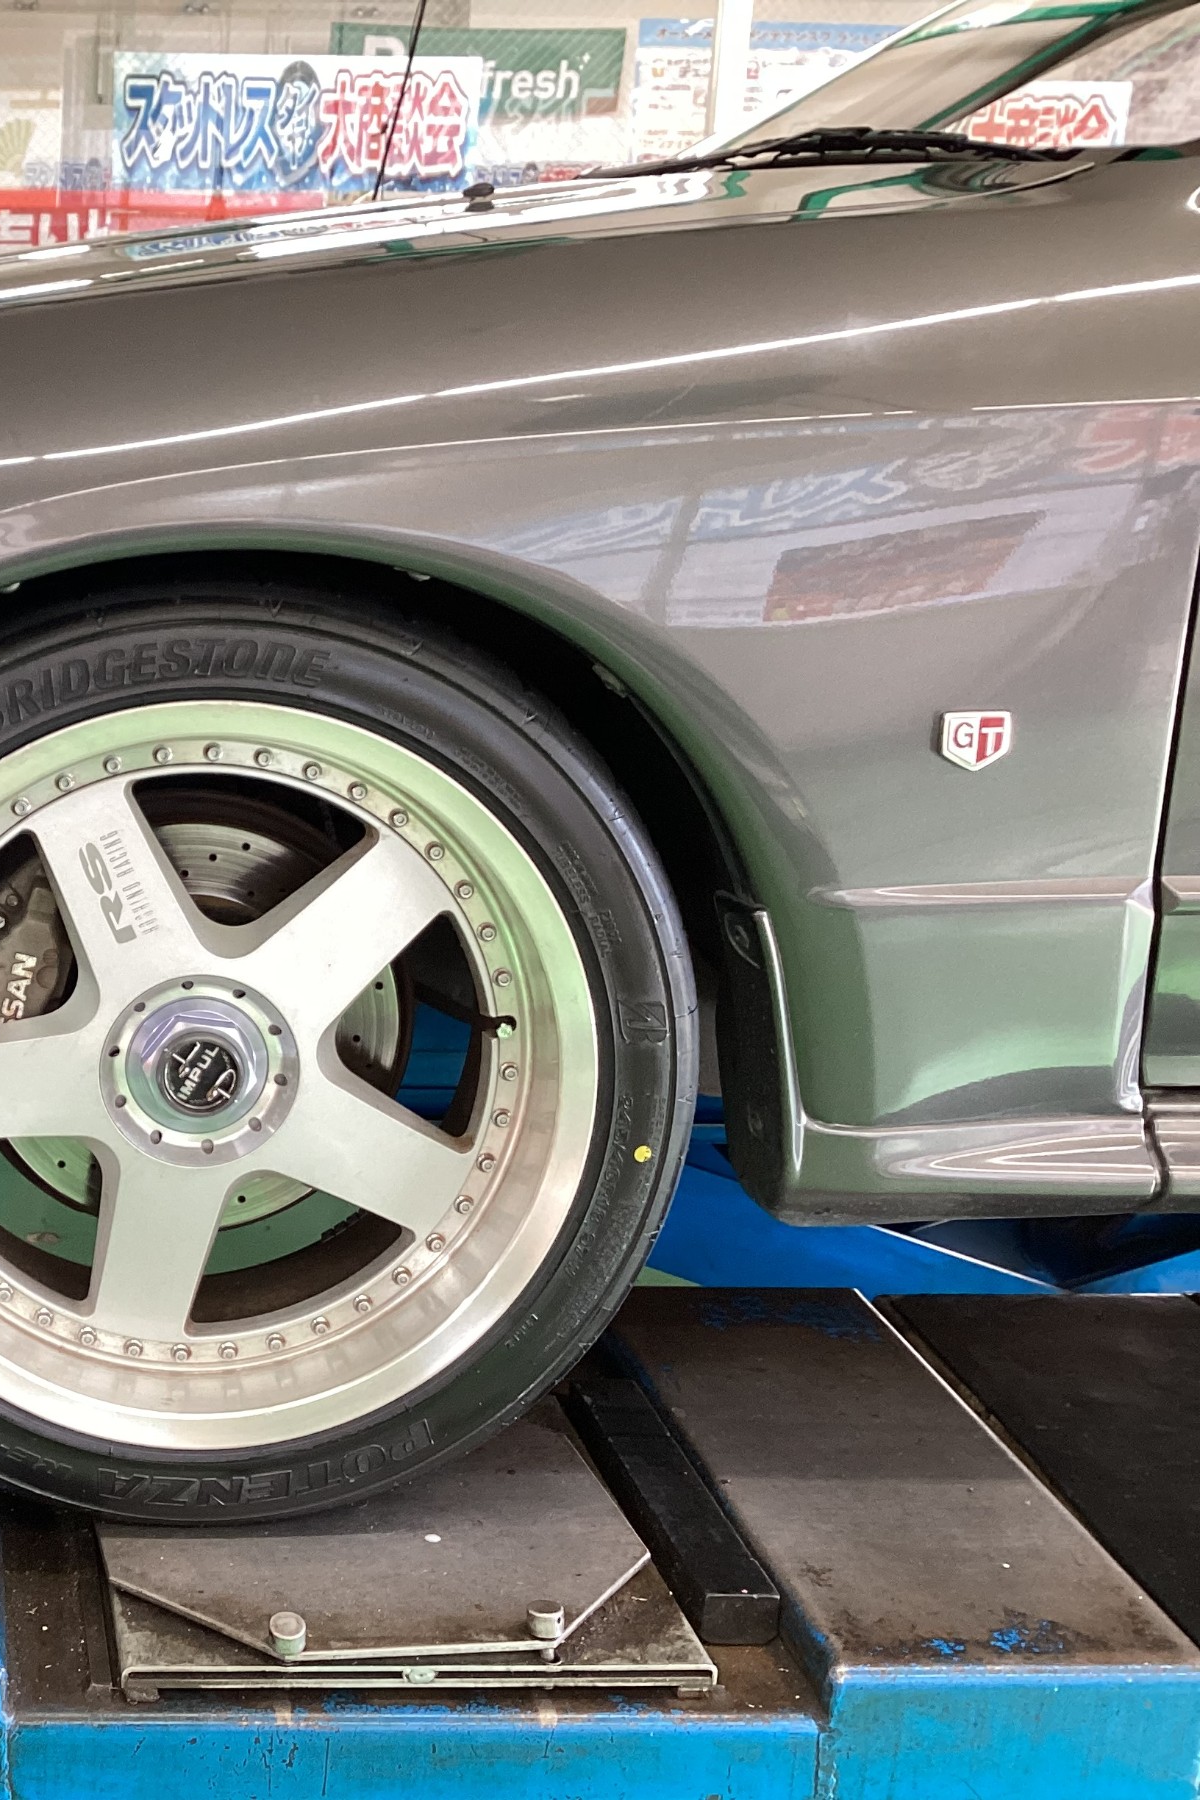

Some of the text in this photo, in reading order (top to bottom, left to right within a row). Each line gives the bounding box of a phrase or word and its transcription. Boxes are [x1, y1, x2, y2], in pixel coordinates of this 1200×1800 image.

[952, 721, 1005, 761] GT
[99, 829, 135, 879] RACING
[78, 842, 138, 945] RS
[176, 1046, 220, 1100] IMPUL
[97, 1417, 435, 1507] POTENZA
